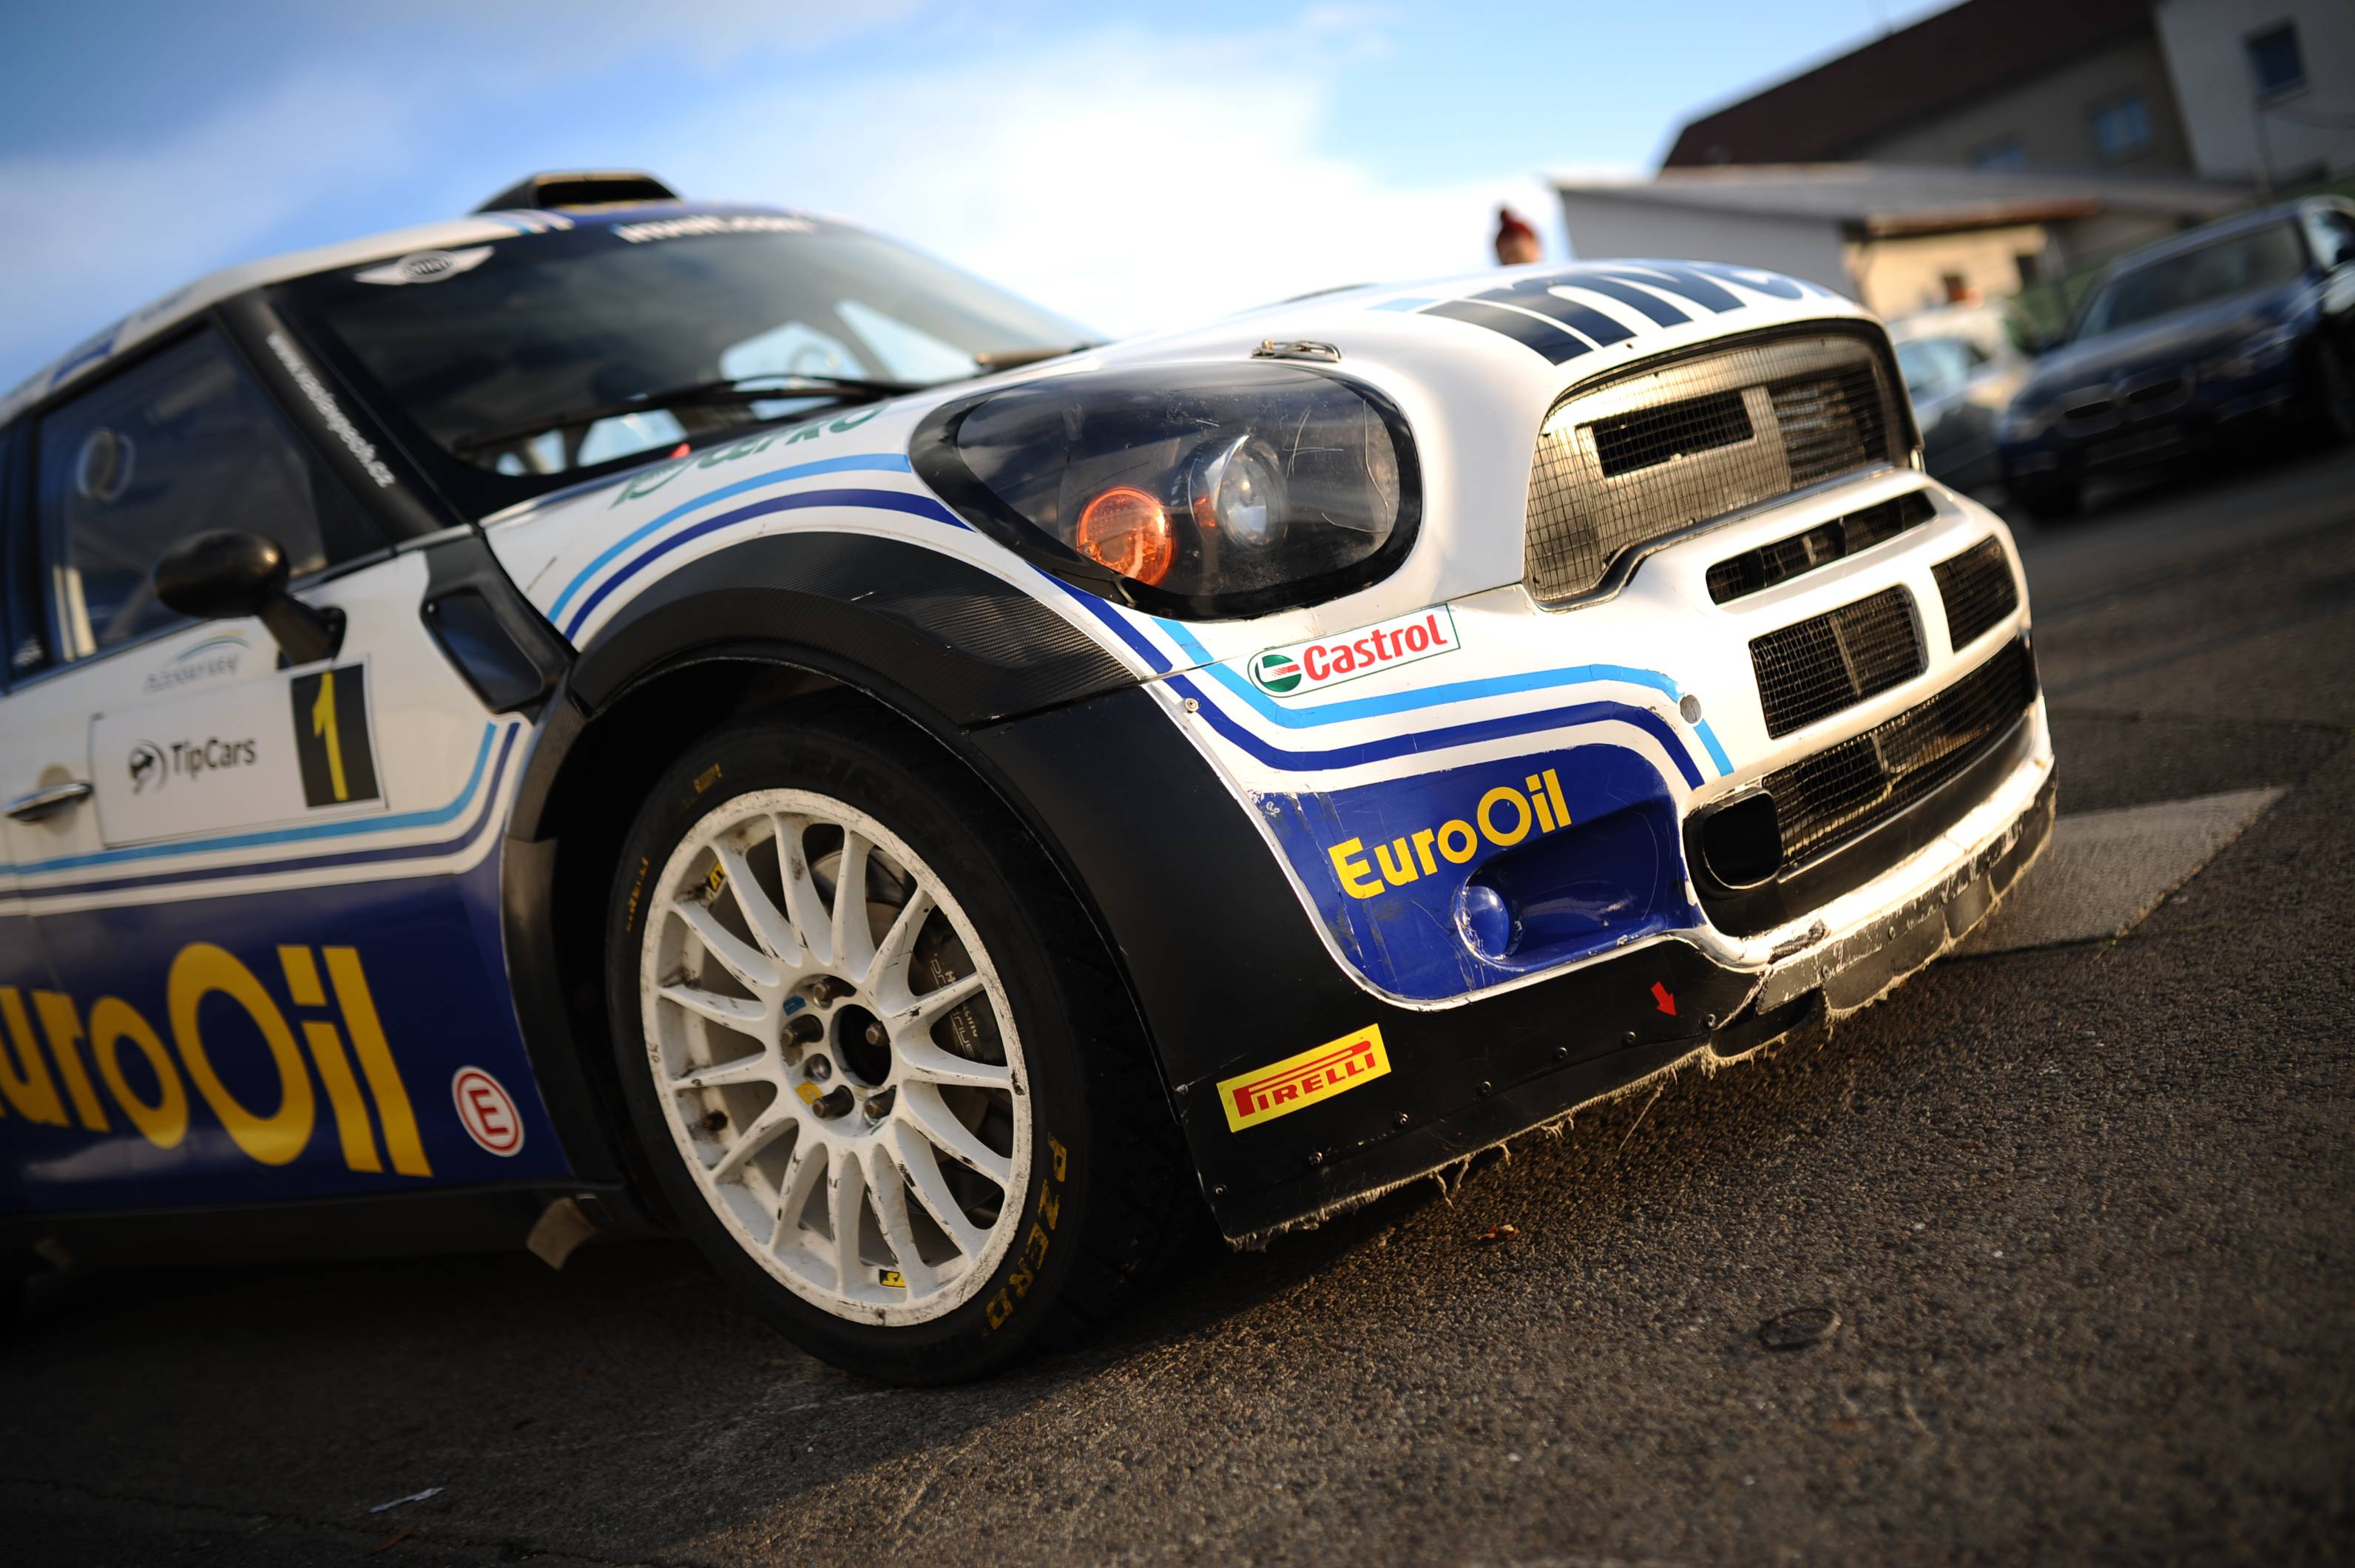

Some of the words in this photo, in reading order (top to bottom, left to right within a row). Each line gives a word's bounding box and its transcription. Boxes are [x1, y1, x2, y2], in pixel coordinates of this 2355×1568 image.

[1302, 615, 1447, 681] Castrol
[170, 737, 257, 780] TipCars
[312, 674, 349, 801] 1
[1328, 768, 1572, 899] EuroOil
[0, 942, 433, 1177] uroOil
[1232, 1041, 1376, 1117] PIRELLI
[468, 1089, 509, 1135] E
